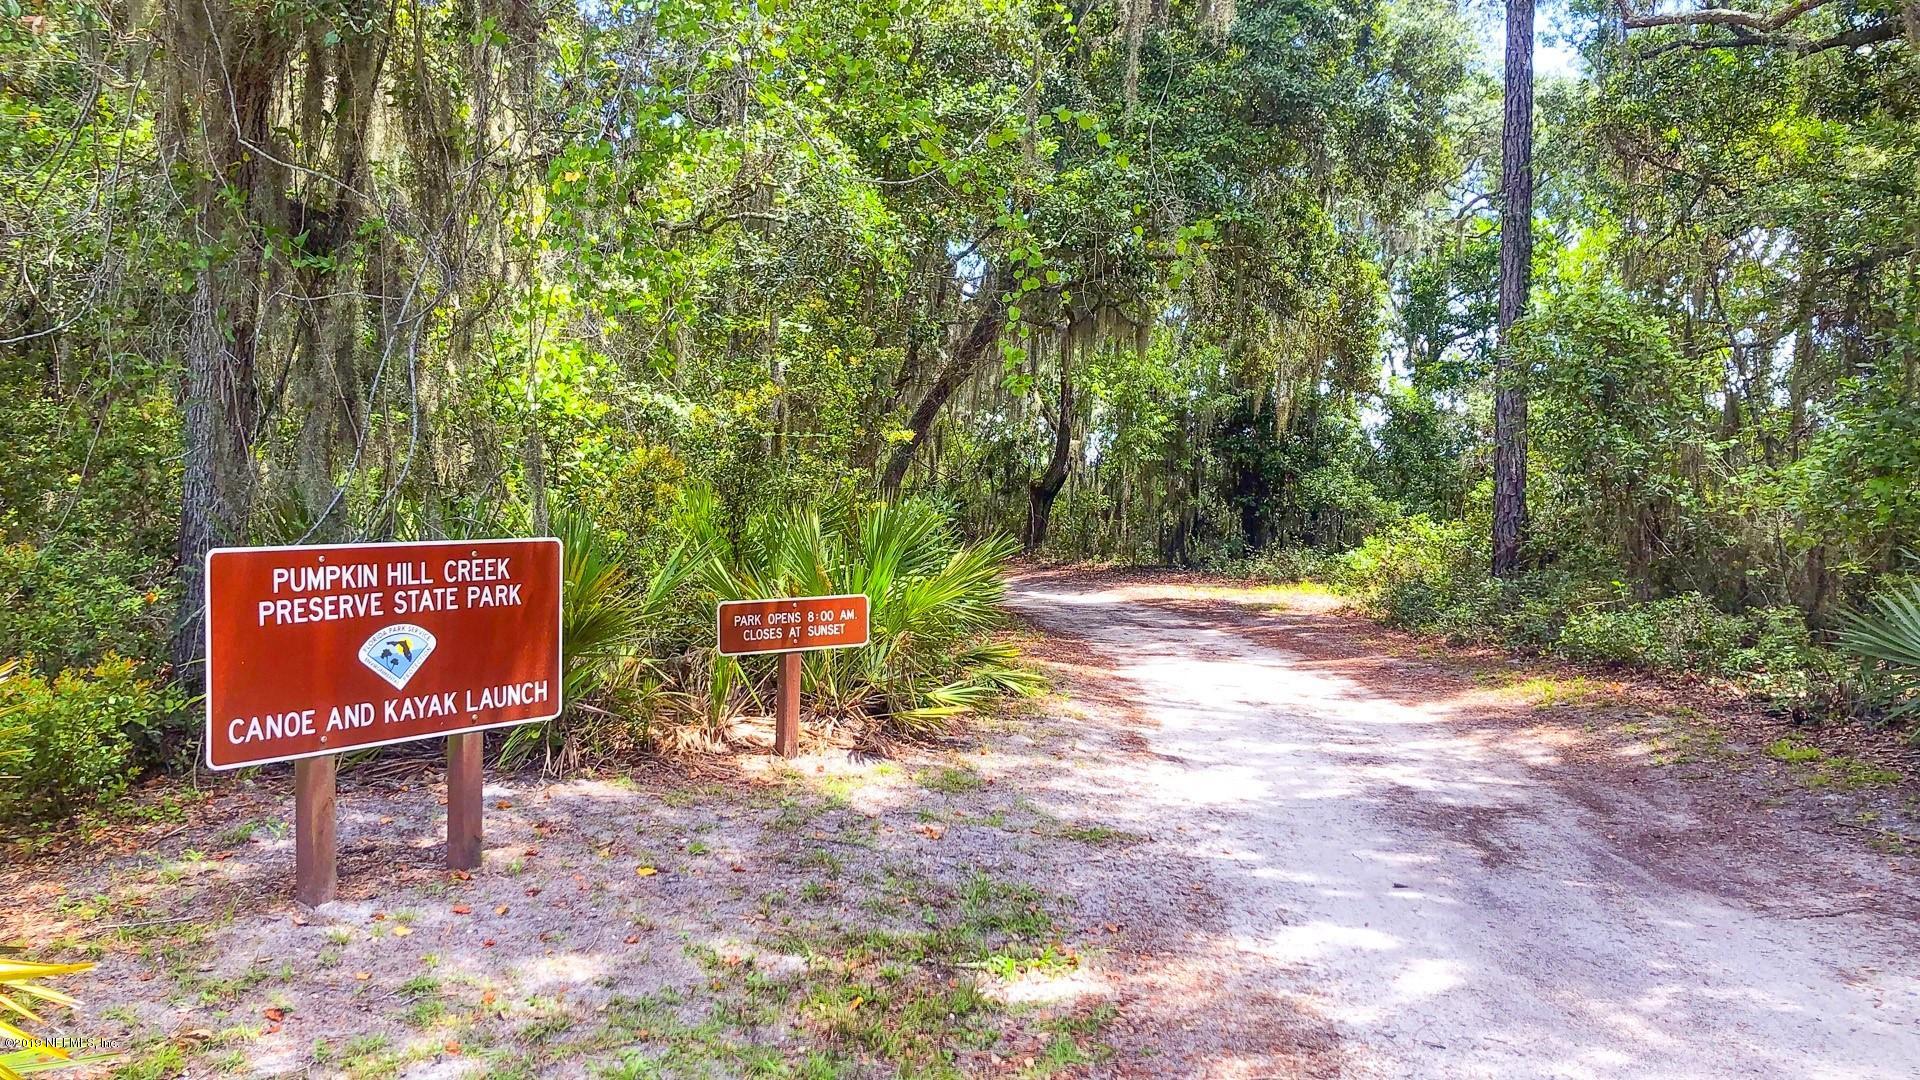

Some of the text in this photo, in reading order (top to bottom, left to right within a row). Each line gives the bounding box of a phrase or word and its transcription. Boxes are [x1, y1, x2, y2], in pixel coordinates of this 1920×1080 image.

[273, 557, 510, 593] PUMPKIN HILL CREEK
[258, 584, 522, 626] PRESERVE STATE PARK
[734, 614, 761, 626] PARK
[768, 612, 801, 625] OPENS
[807, 610, 834, 622] 8:00
[389, 625, 406, 633] PARK
[408, 626, 431, 641] SERVICE
[743, 623, 846, 641] CLOSES AT SUNSET
[228, 680, 548, 744] CANOE AND KAYAK LAUNCH
